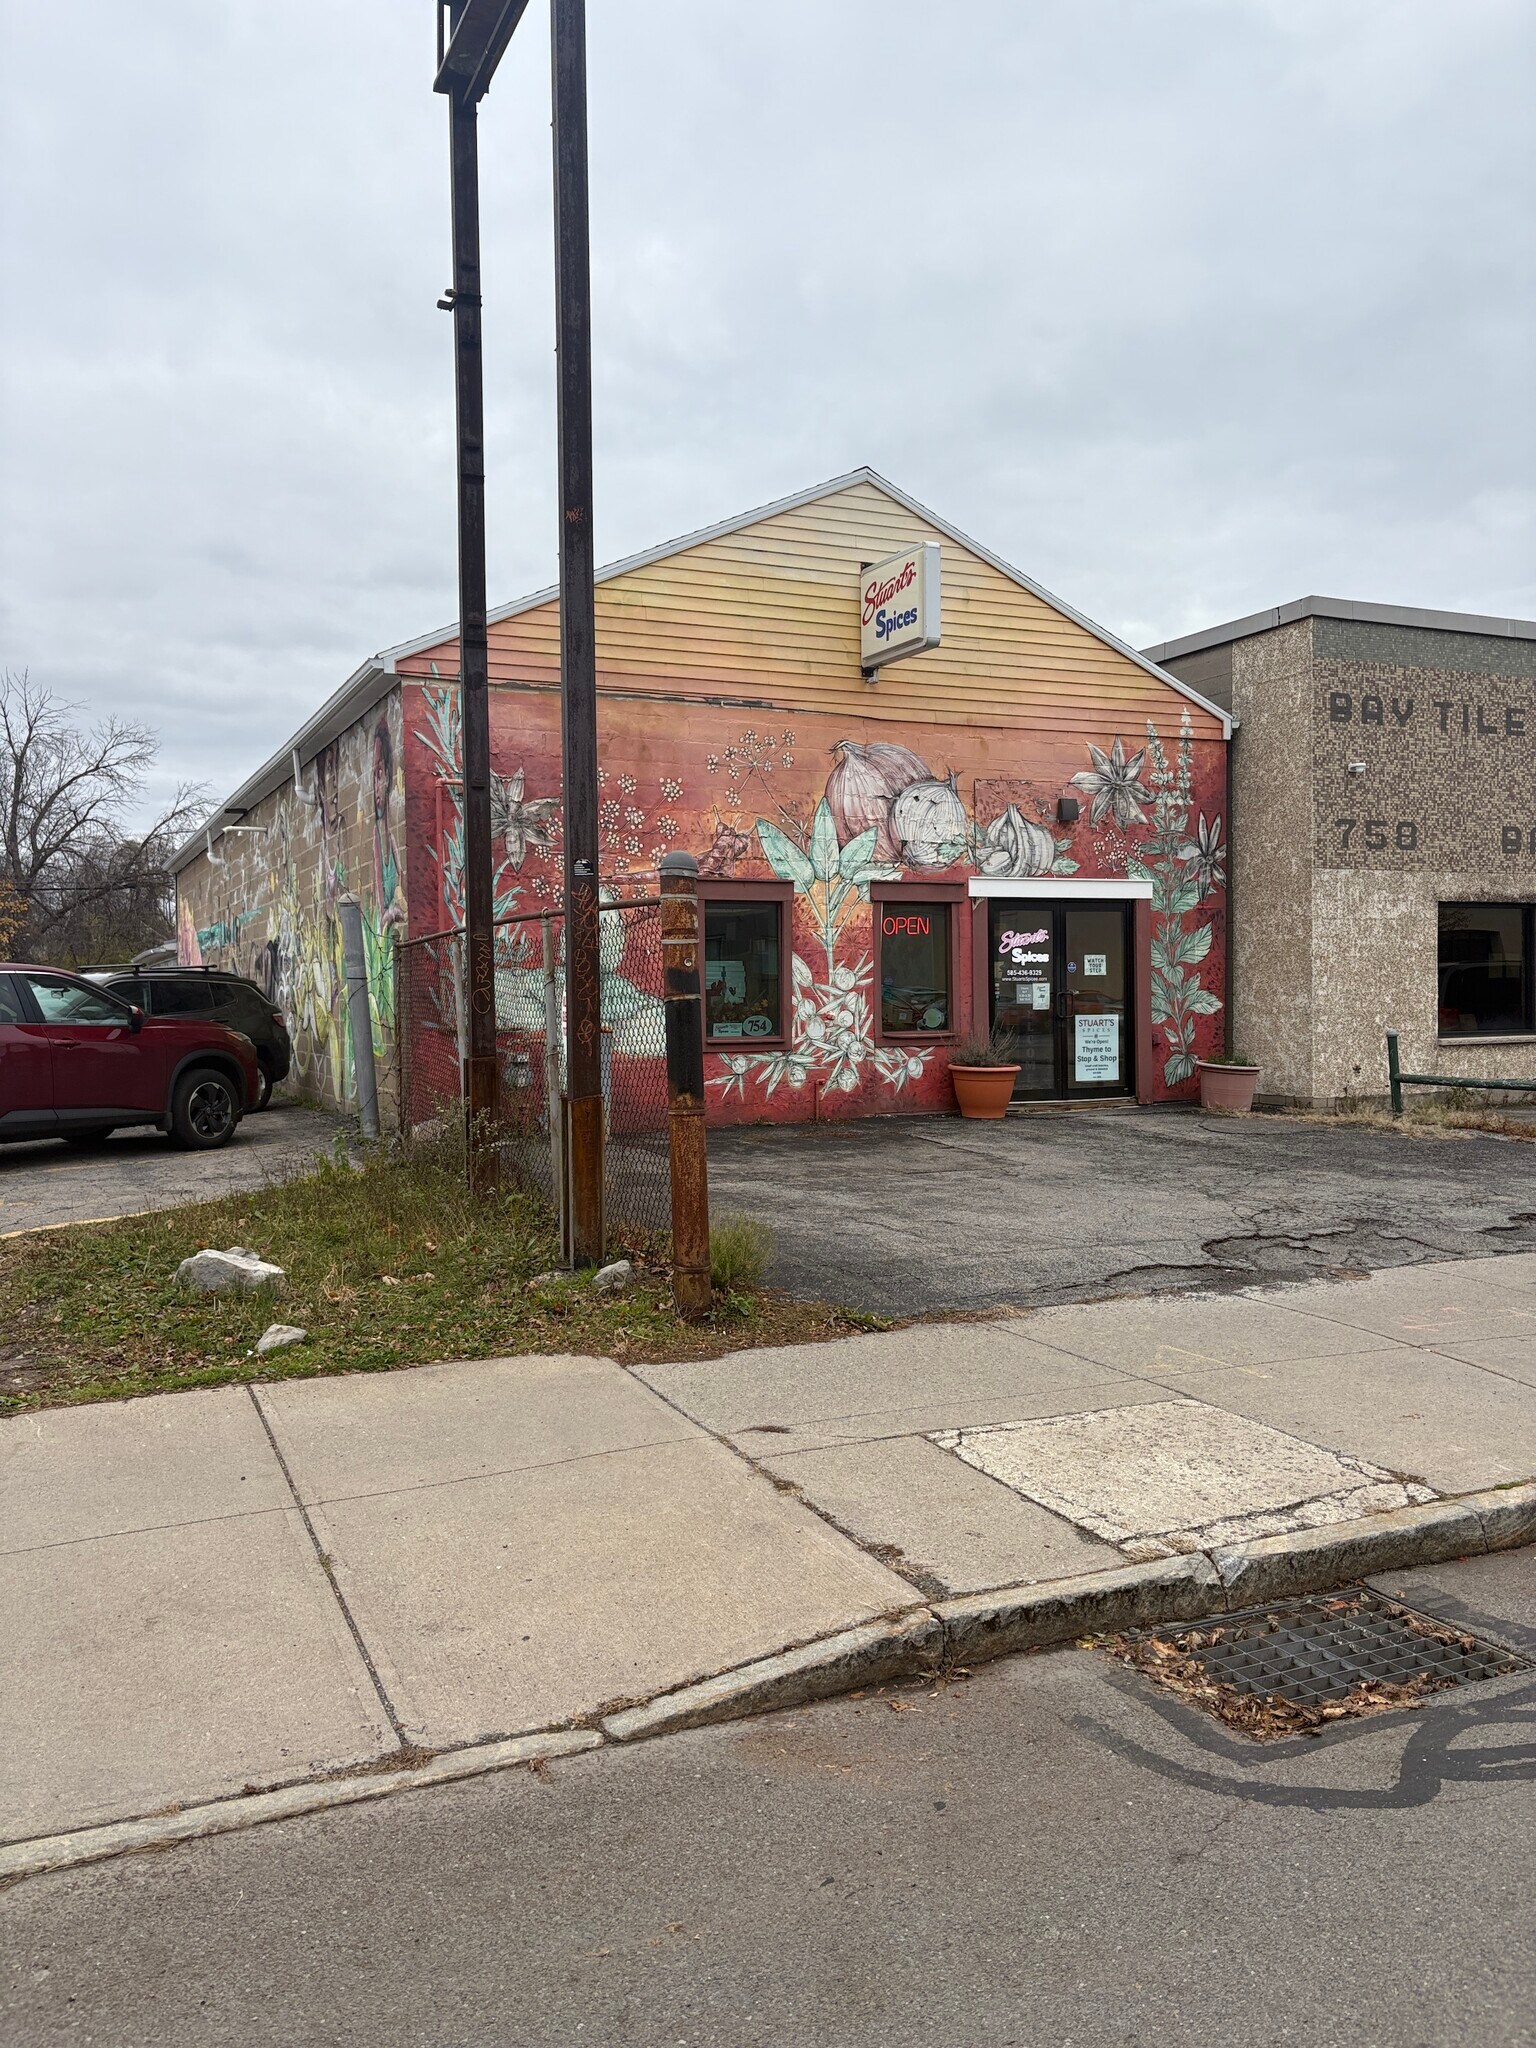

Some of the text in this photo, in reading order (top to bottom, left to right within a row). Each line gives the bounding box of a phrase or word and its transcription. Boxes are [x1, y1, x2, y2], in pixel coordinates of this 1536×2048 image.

[876, 607, 917, 641] Spices
[1330, 692, 1526, 736] BAY TILE
[1335, 818, 1418, 850] 758
[883, 916, 930, 935] OPEN
[1011, 947, 1050, 966] Spices
[747, 1019, 767, 1032] 754
[1078, 1018, 1115, 1027] STUART'S
[1077, 1055, 1092, 1063] Stop
[1099, 1054, 1118, 1063] Shop
[1081, 1046, 1104, 1054] Thyme
